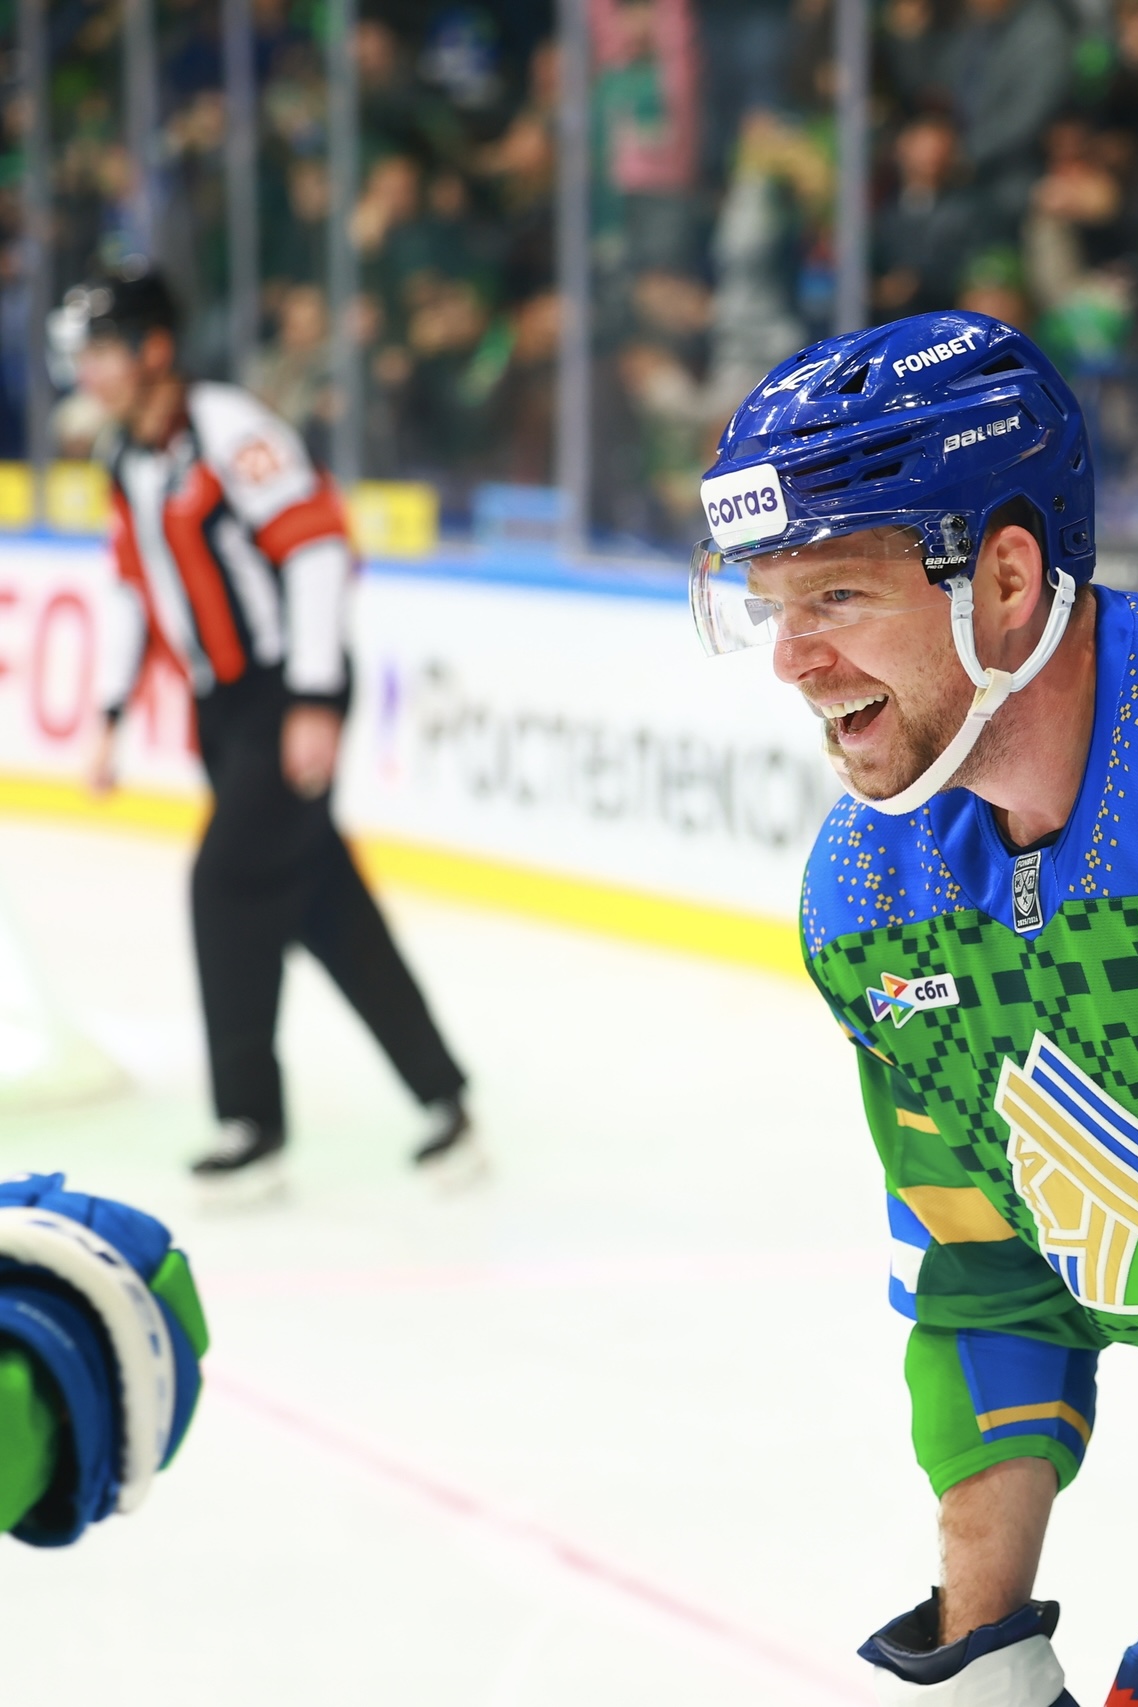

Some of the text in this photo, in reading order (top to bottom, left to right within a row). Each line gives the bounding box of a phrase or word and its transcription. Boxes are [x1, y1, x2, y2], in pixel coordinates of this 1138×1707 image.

[892, 333, 976, 378] FONBET
[943, 415, 1022, 453] BAUER
[708, 487, 778, 527] согаз
[925, 556, 967, 565] BAUER
[915, 981, 949, 1001] сбп
